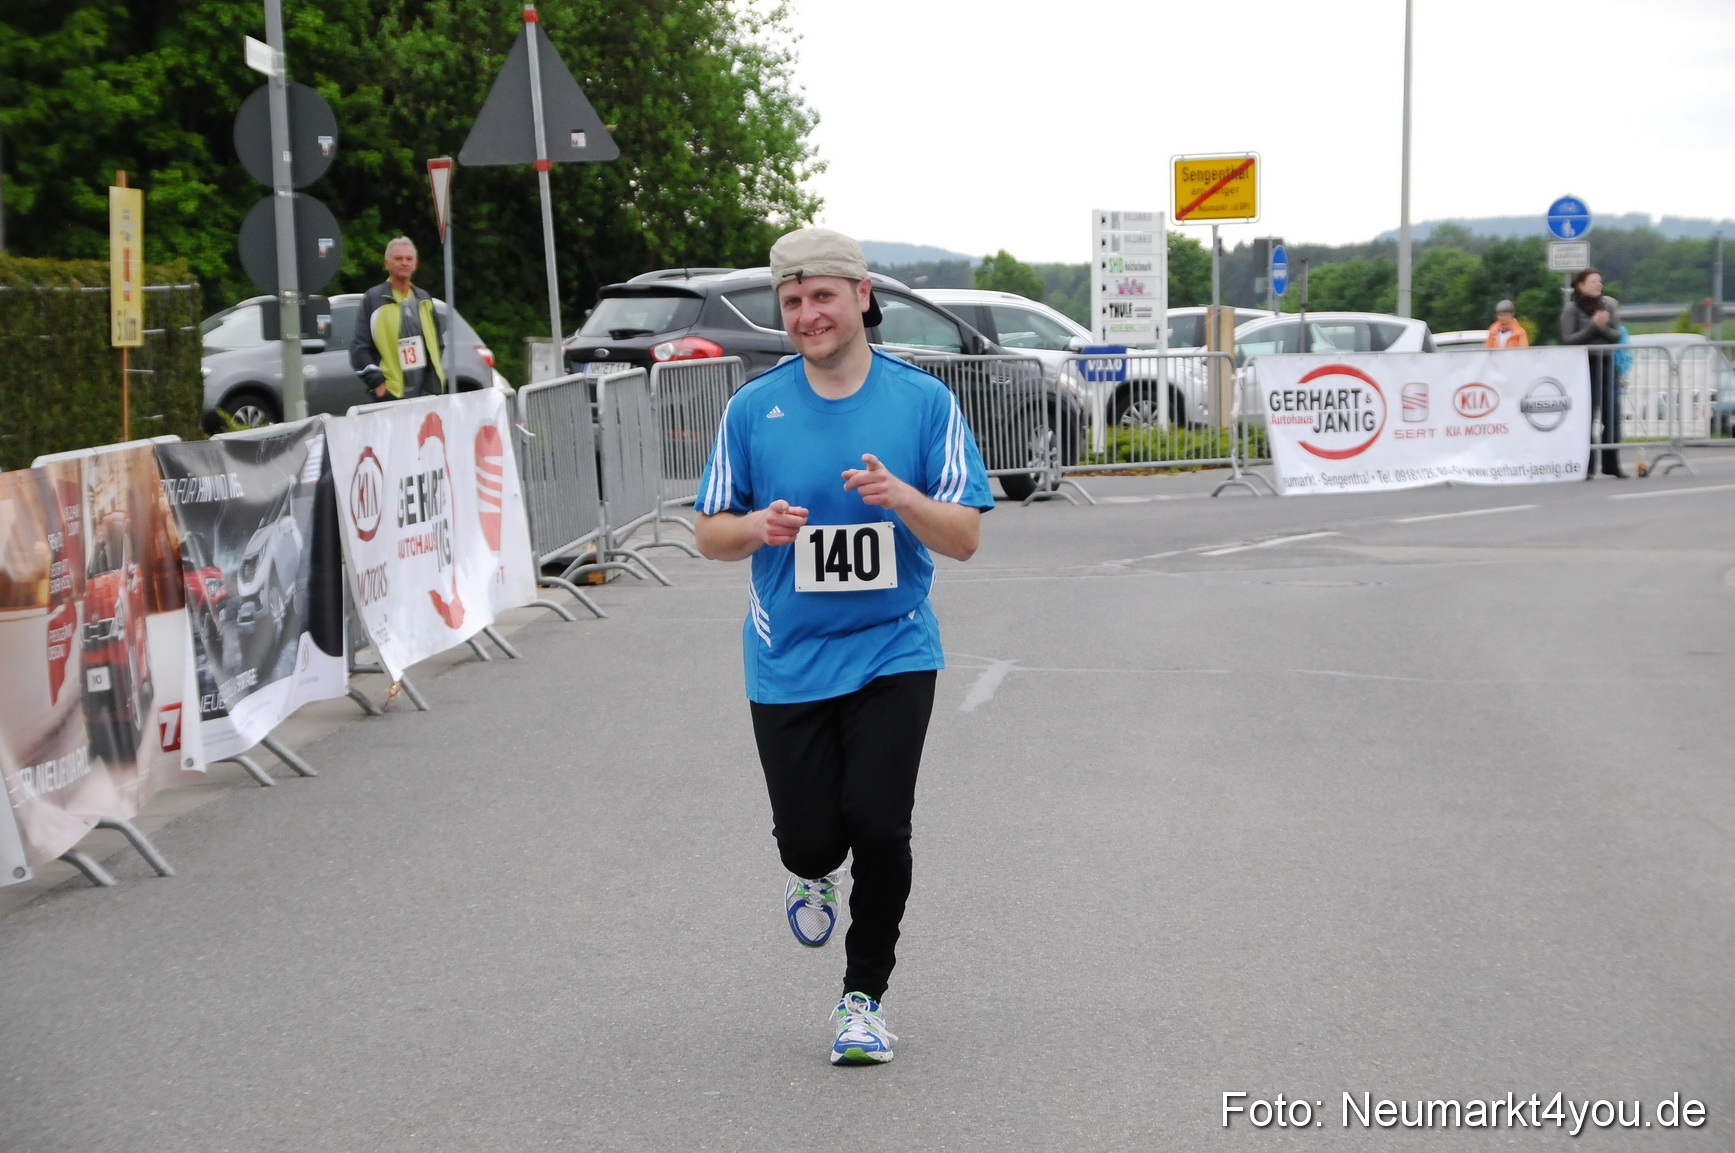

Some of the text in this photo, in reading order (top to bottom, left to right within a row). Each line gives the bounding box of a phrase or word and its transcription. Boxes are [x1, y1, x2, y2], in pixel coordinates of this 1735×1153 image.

[1182, 165, 1249, 185] Sengenthal
[401, 346, 417, 365] 13
[1270, 388, 1363, 412] GERHART
[1460, 391, 1491, 410] KIA
[1526, 399, 1568, 410] NISSAN
[1271, 410, 1376, 434] Autohaus JÄNIG
[1446, 423, 1510, 437] KIA MOTORS
[1283, 474, 1316, 488] eumarkt
[1321, 472, 1370, 488] Sengenthal
[357, 470, 379, 520] KIA
[809, 527, 881, 582] 140
